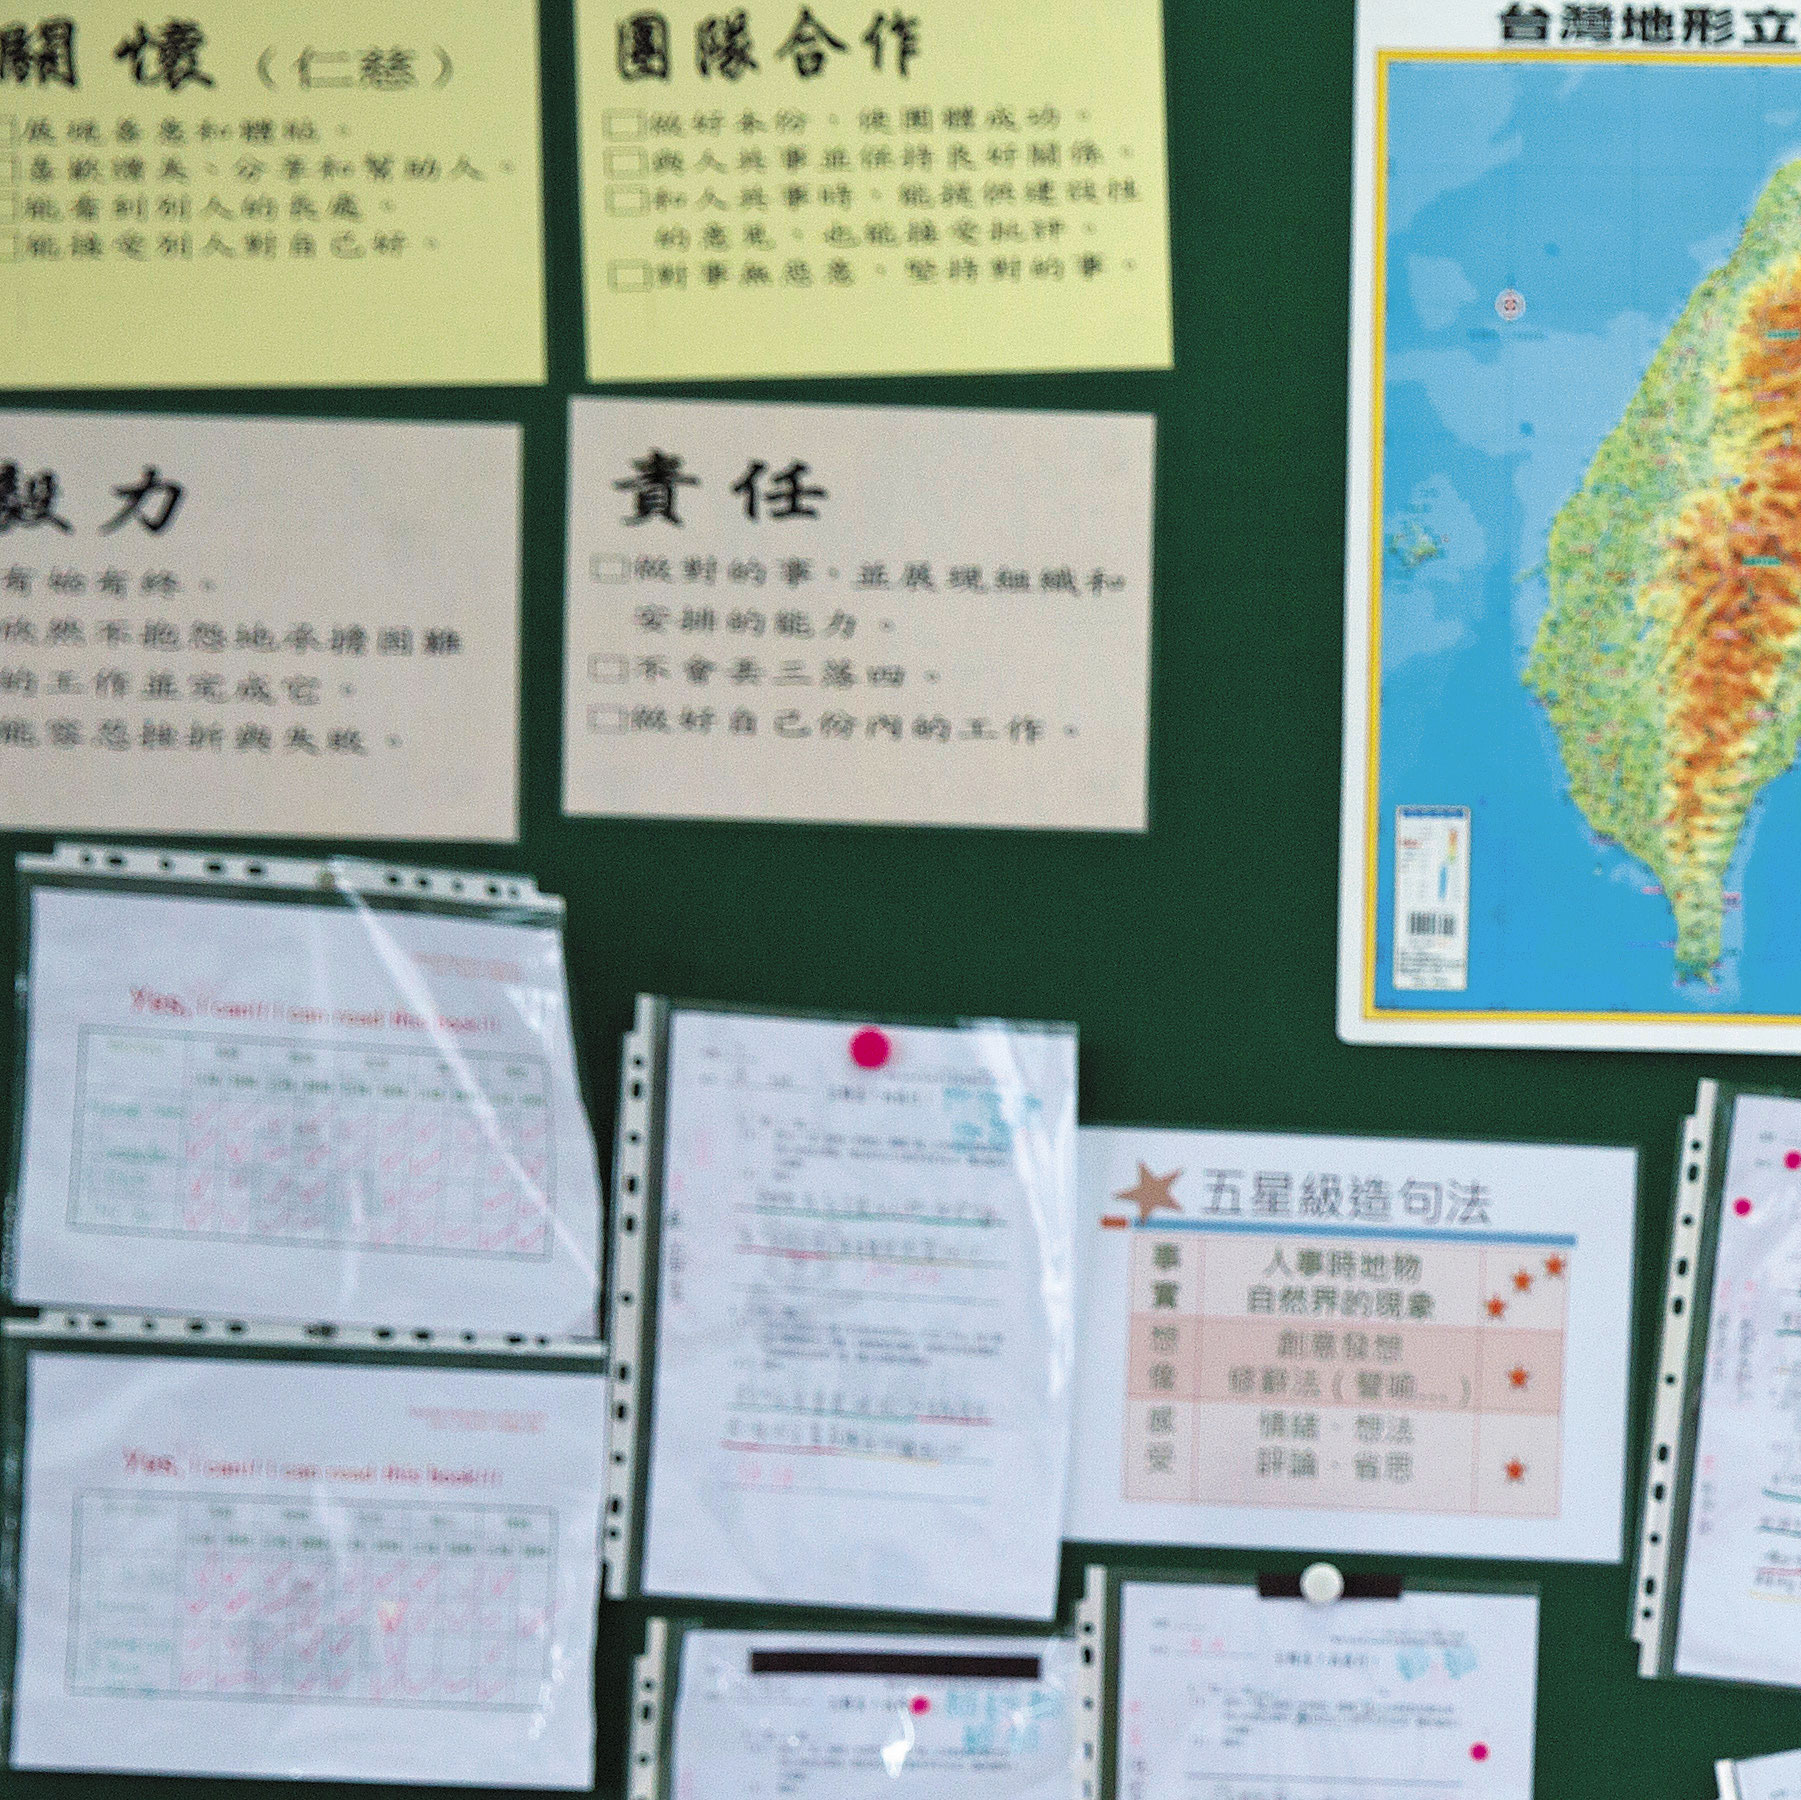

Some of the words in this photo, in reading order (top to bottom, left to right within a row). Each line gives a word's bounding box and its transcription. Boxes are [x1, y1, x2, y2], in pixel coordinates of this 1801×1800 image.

[0, 16, 218, 90] 關懷
[615, 8, 922, 82] 團隊合作
[613, 448, 829, 527] 責任
[1201, 1167, 1492, 1226] 五星級造句法
[1247, 1283, 1436, 1321] 自然界的現象
